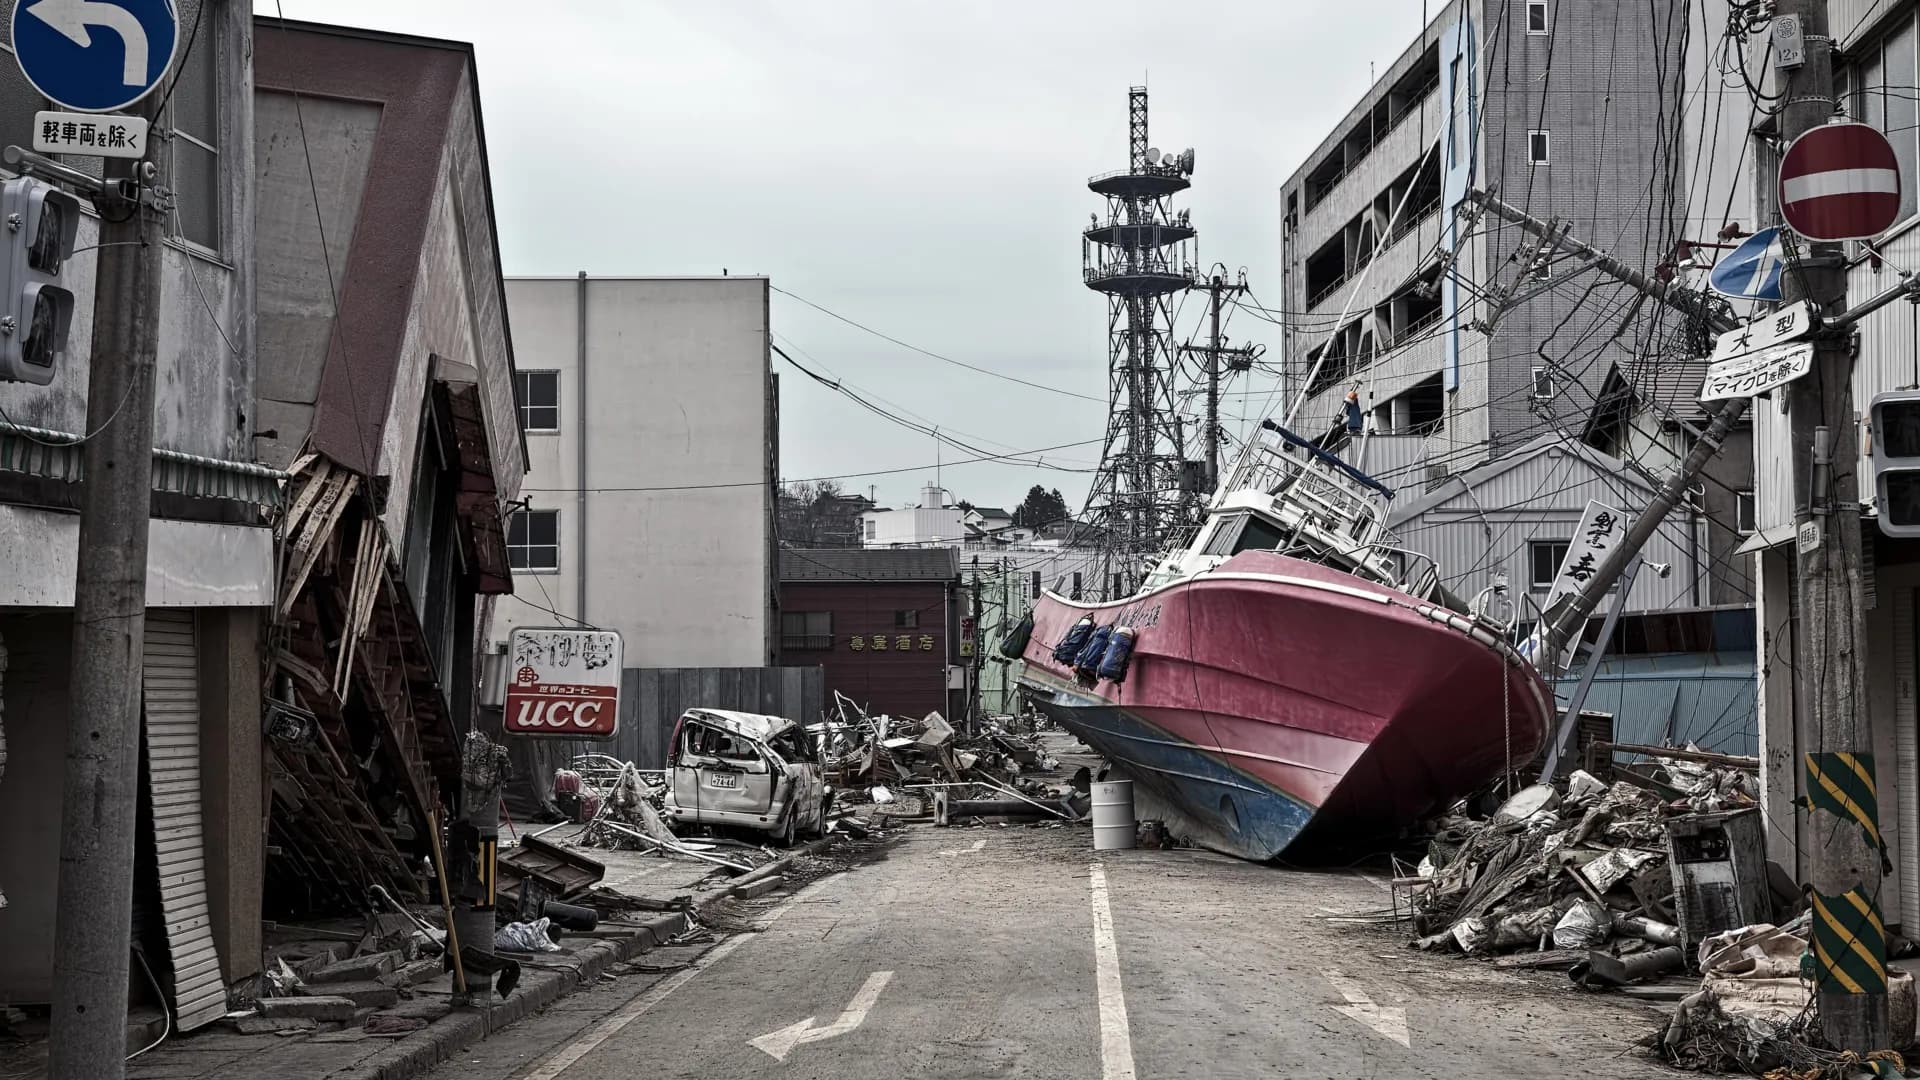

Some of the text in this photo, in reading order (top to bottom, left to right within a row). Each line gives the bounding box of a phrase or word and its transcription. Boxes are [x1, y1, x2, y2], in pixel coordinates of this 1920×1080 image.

[42, 120, 137, 149] 軽車両を除く
[1730, 312, 1795, 353] 大型
